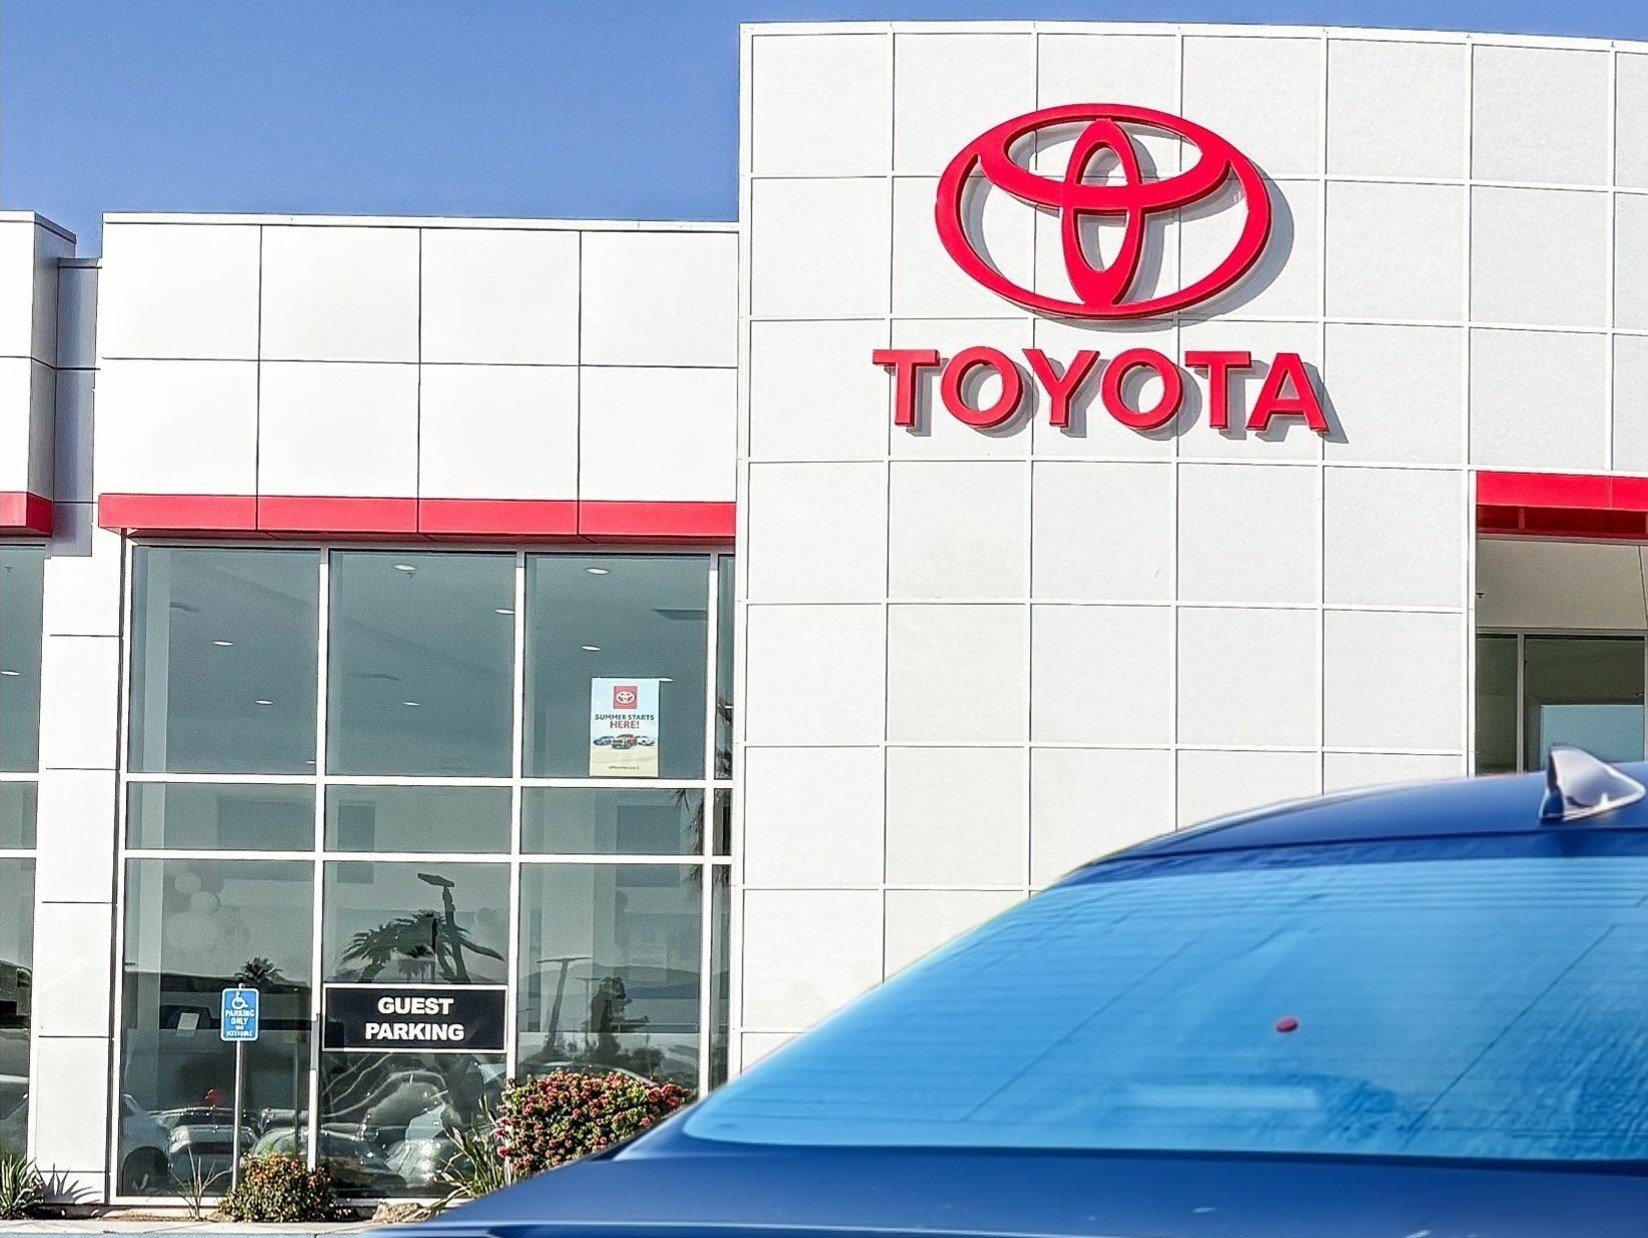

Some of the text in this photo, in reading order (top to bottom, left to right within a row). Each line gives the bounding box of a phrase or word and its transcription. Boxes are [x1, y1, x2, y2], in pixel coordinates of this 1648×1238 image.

[872, 345, 1331, 432] TOYOTA
[609, 720, 641, 730] HERE!
[225, 1009, 256, 1018] PARKING
[377, 997, 454, 1015] GUEST
[365, 1022, 464, 1041] PARKING
